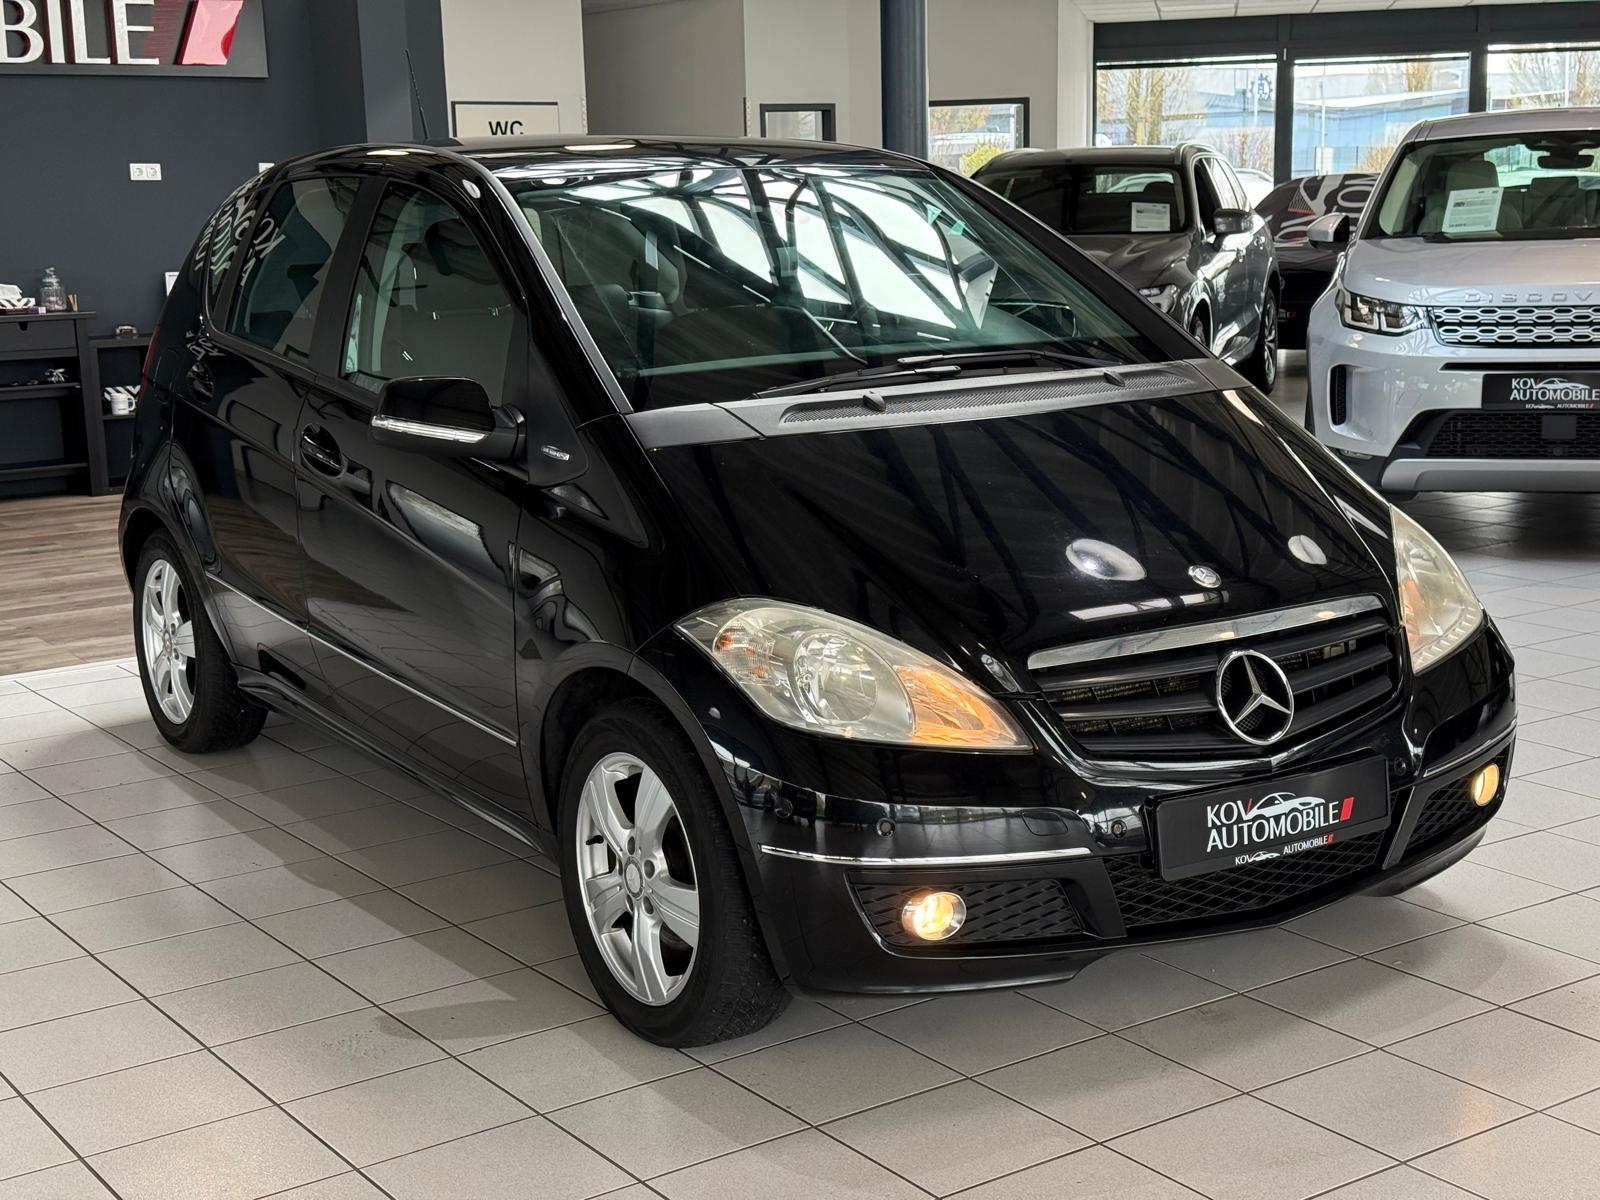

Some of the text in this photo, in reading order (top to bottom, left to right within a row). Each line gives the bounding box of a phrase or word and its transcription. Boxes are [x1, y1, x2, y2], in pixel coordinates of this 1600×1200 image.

[488, 120, 524, 136] WC
[1464, 289, 1593, 303] DISCOV
[1511, 377, 1541, 390] KOV
[1509, 388, 1600, 401] AUTOMOBILE
[1206, 798, 1253, 828] KOV
[1206, 801, 1340, 853] AUTOMOBILE
[1234, 835, 1328, 866] KOV AUTOMOBILE
